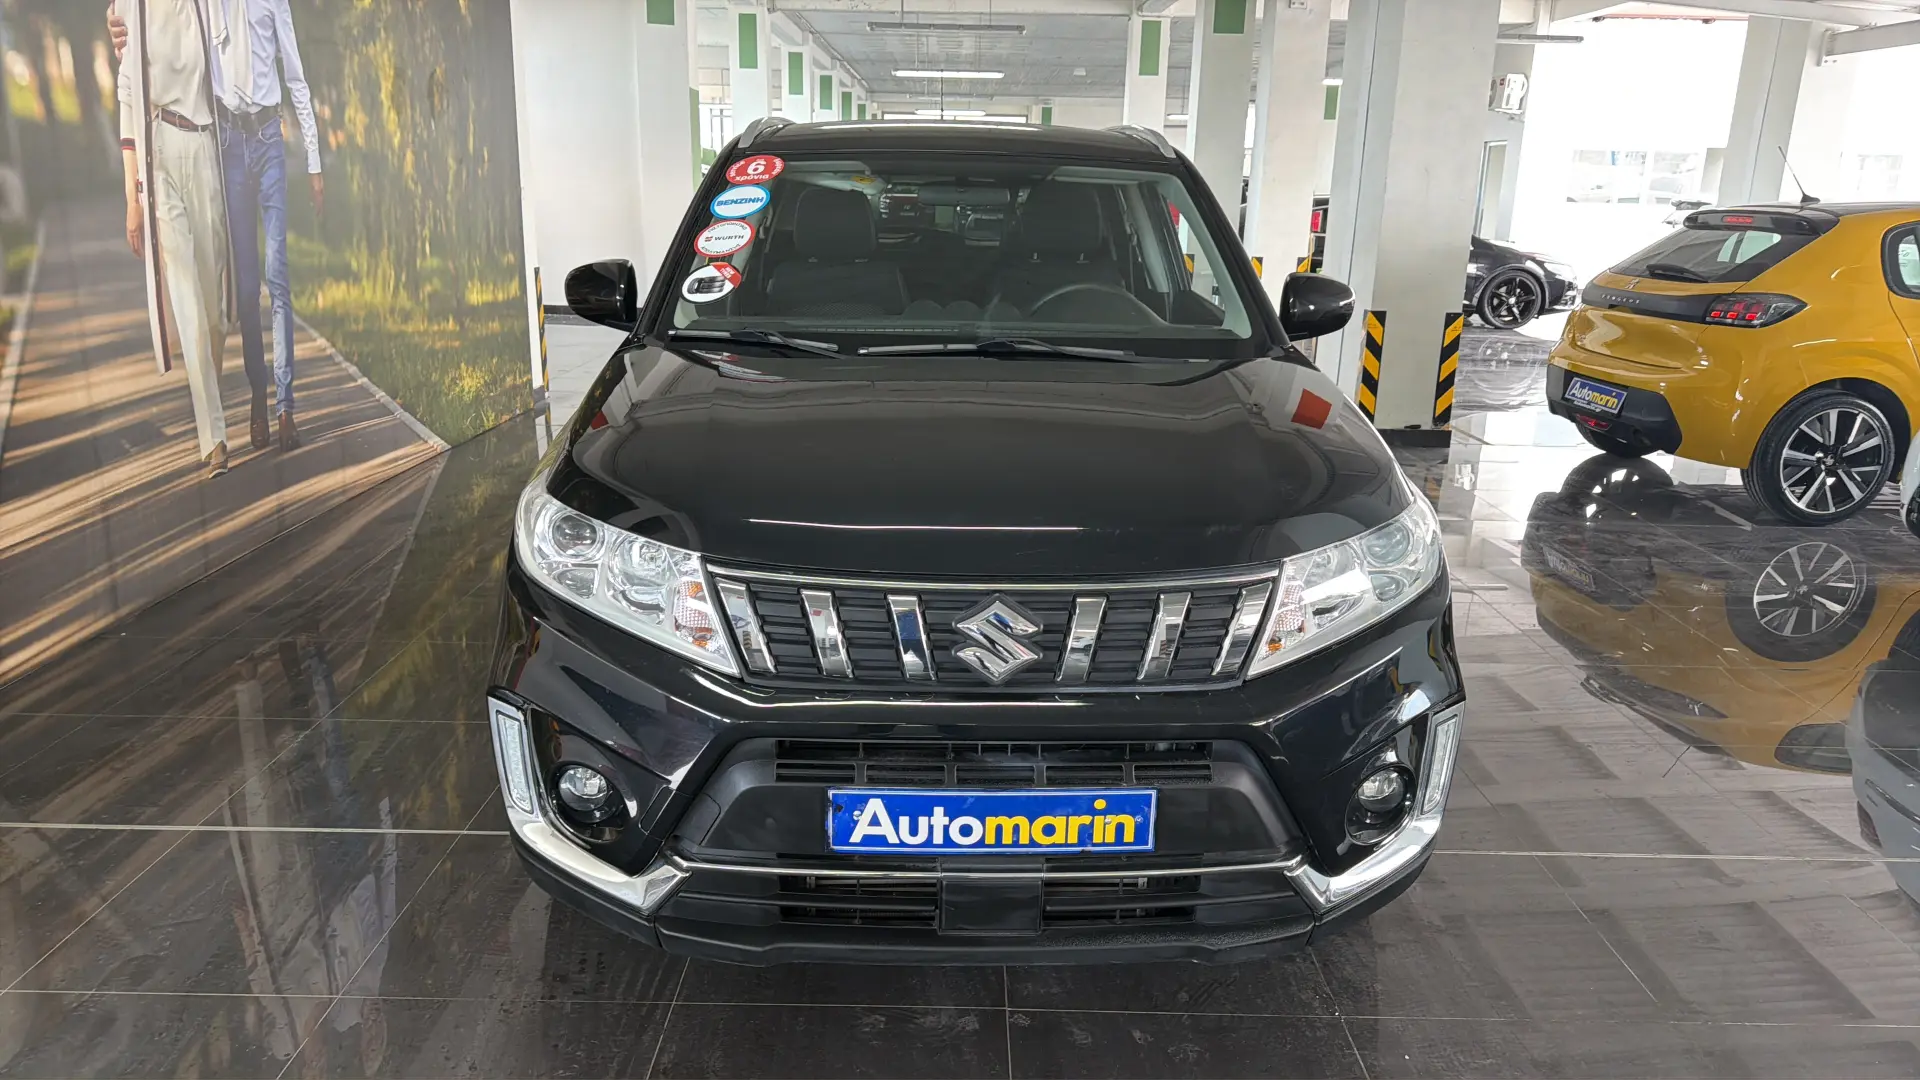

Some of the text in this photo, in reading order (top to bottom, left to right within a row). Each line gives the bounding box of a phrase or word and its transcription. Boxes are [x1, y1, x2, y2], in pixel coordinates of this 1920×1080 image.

[746, 160, 767, 175] 6
[734, 173, 770, 181] χρόνια
[716, 196, 765, 206] ΒΕΝΖΙΝΗ
[1569, 381, 1619, 409] Automarin
[849, 798, 1135, 845] Automarin
